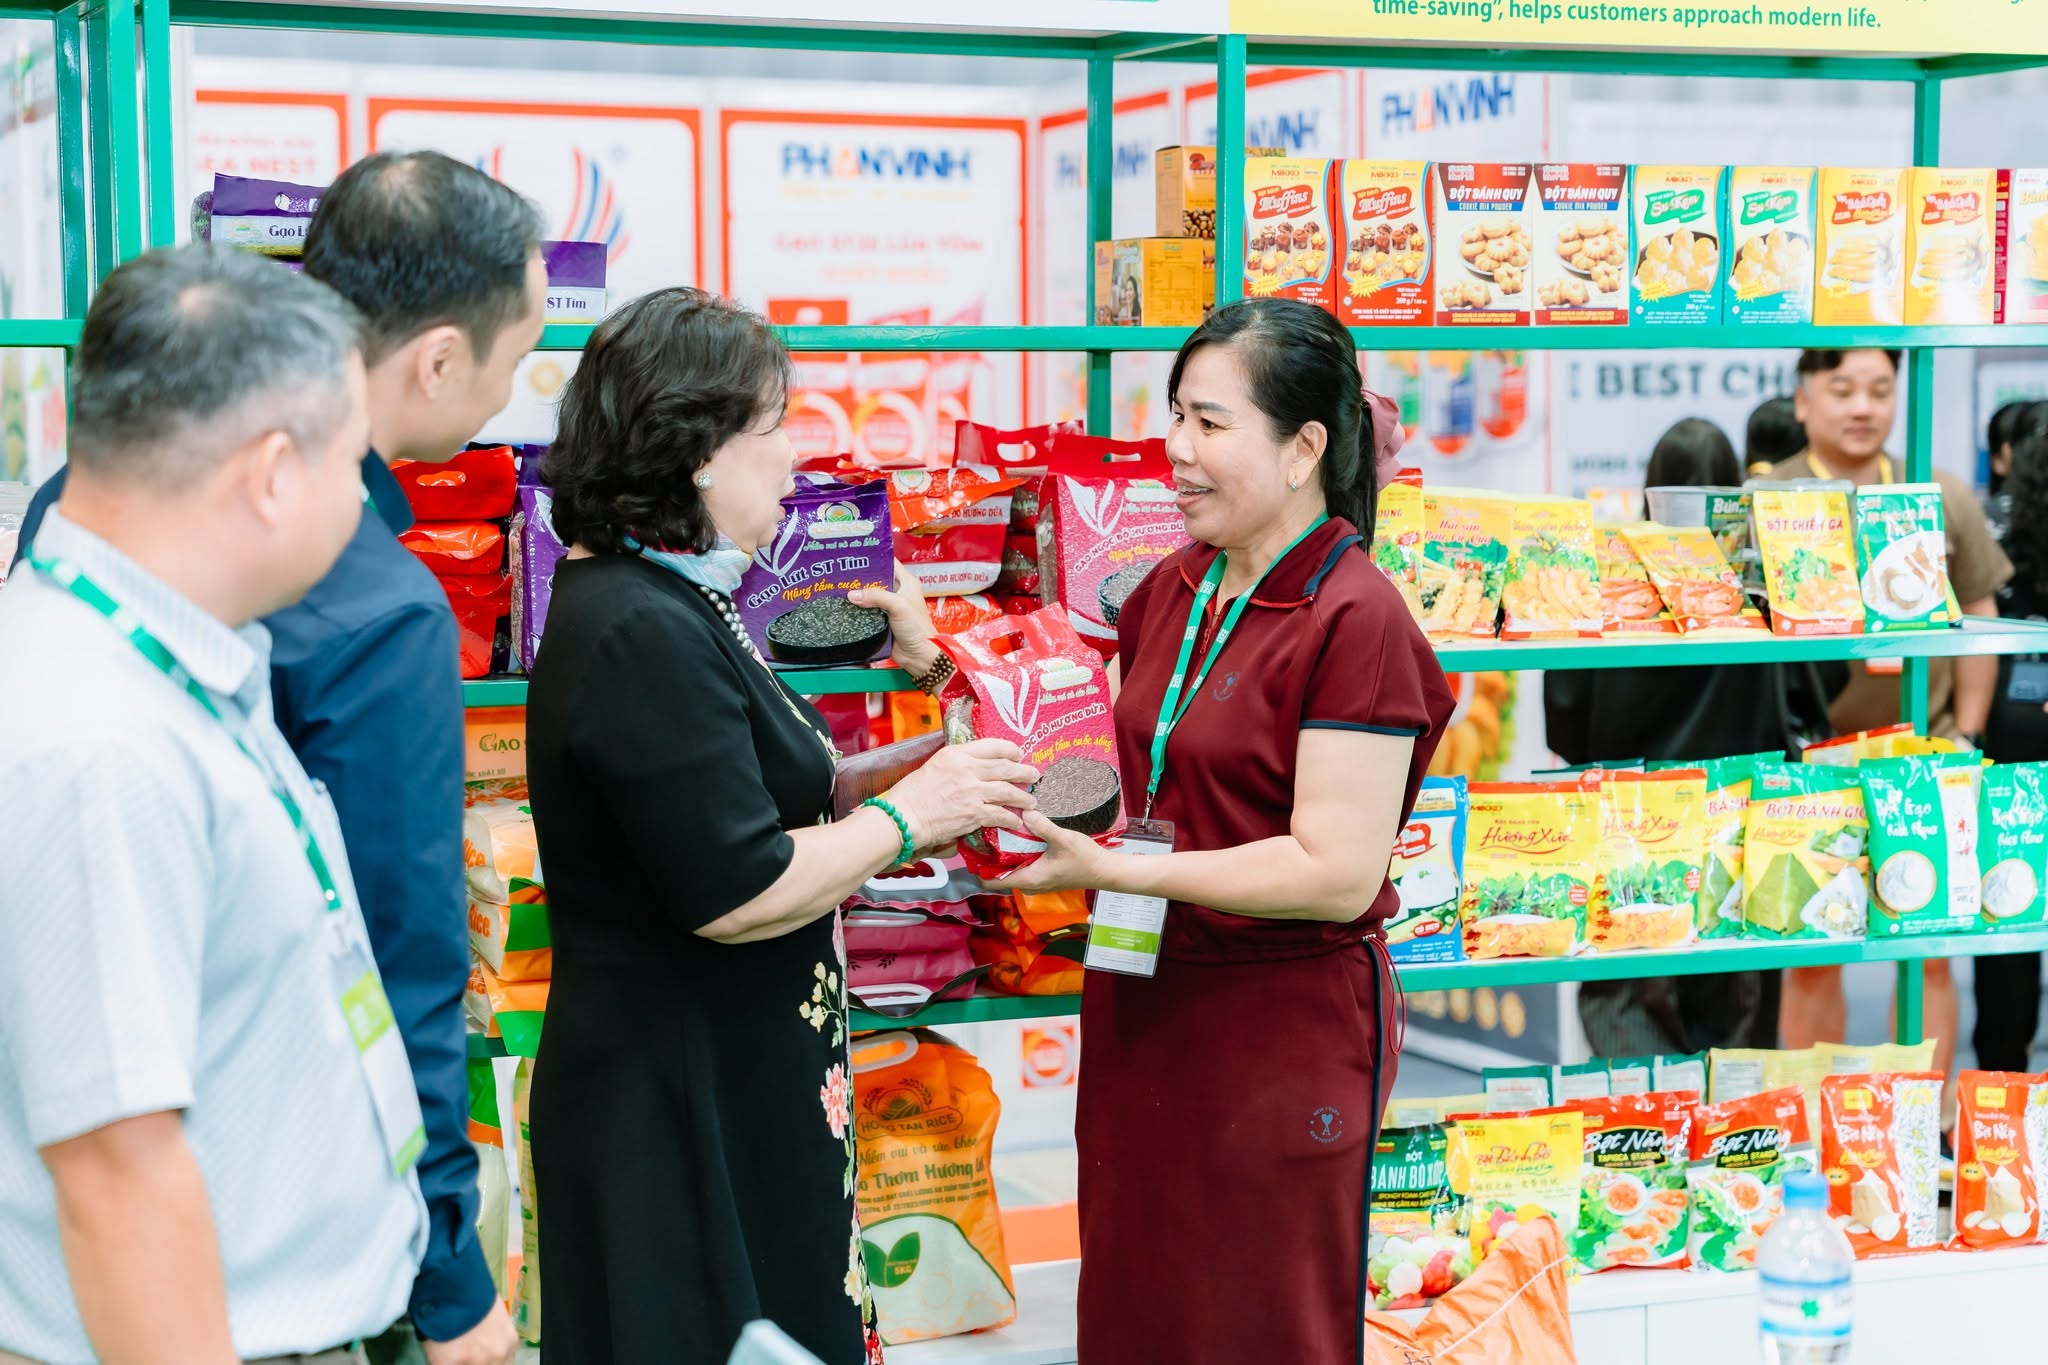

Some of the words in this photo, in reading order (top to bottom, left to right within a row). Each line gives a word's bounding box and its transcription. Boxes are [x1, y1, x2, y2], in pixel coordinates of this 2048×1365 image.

[1509, 0, 1562, 24] helps
[1567, 2, 1667, 22] customers
[1673, 5, 1763, 28] approach
[1768, 6, 1842, 27] modern
[1847, 8, 1882, 28] life.
[1259, 188, 1309, 214] Muffins
[1358, 190, 1407, 216] Muffins
[1471, 185, 1503, 200] BÁNH
[1503, 187, 1524, 201] QUY
[1567, 185, 1597, 200] BÁNH
[1597, 187, 1618, 201] QUY
[269, 225, 296, 239] Gạo
[547, 297, 563, 309] ST
[1597, 361, 1706, 399] BEST
[747, 583, 781, 609] Gạo
[811, 559, 835, 578] ST
[1050, 709, 1085, 733] HƯƠNG
[468, 903, 491, 938] Rice
[926, 1113, 955, 1128] RICE
[1583, 1132, 1625, 1155] Bột
[1702, 1134, 1748, 1159] Bột
[1743, 1127, 1792, 1153] Năng
[1405, 1150, 1423, 1163] BỘT
[872, 1169, 919, 1189] Thơm
[924, 1161, 974, 1180] Hương
